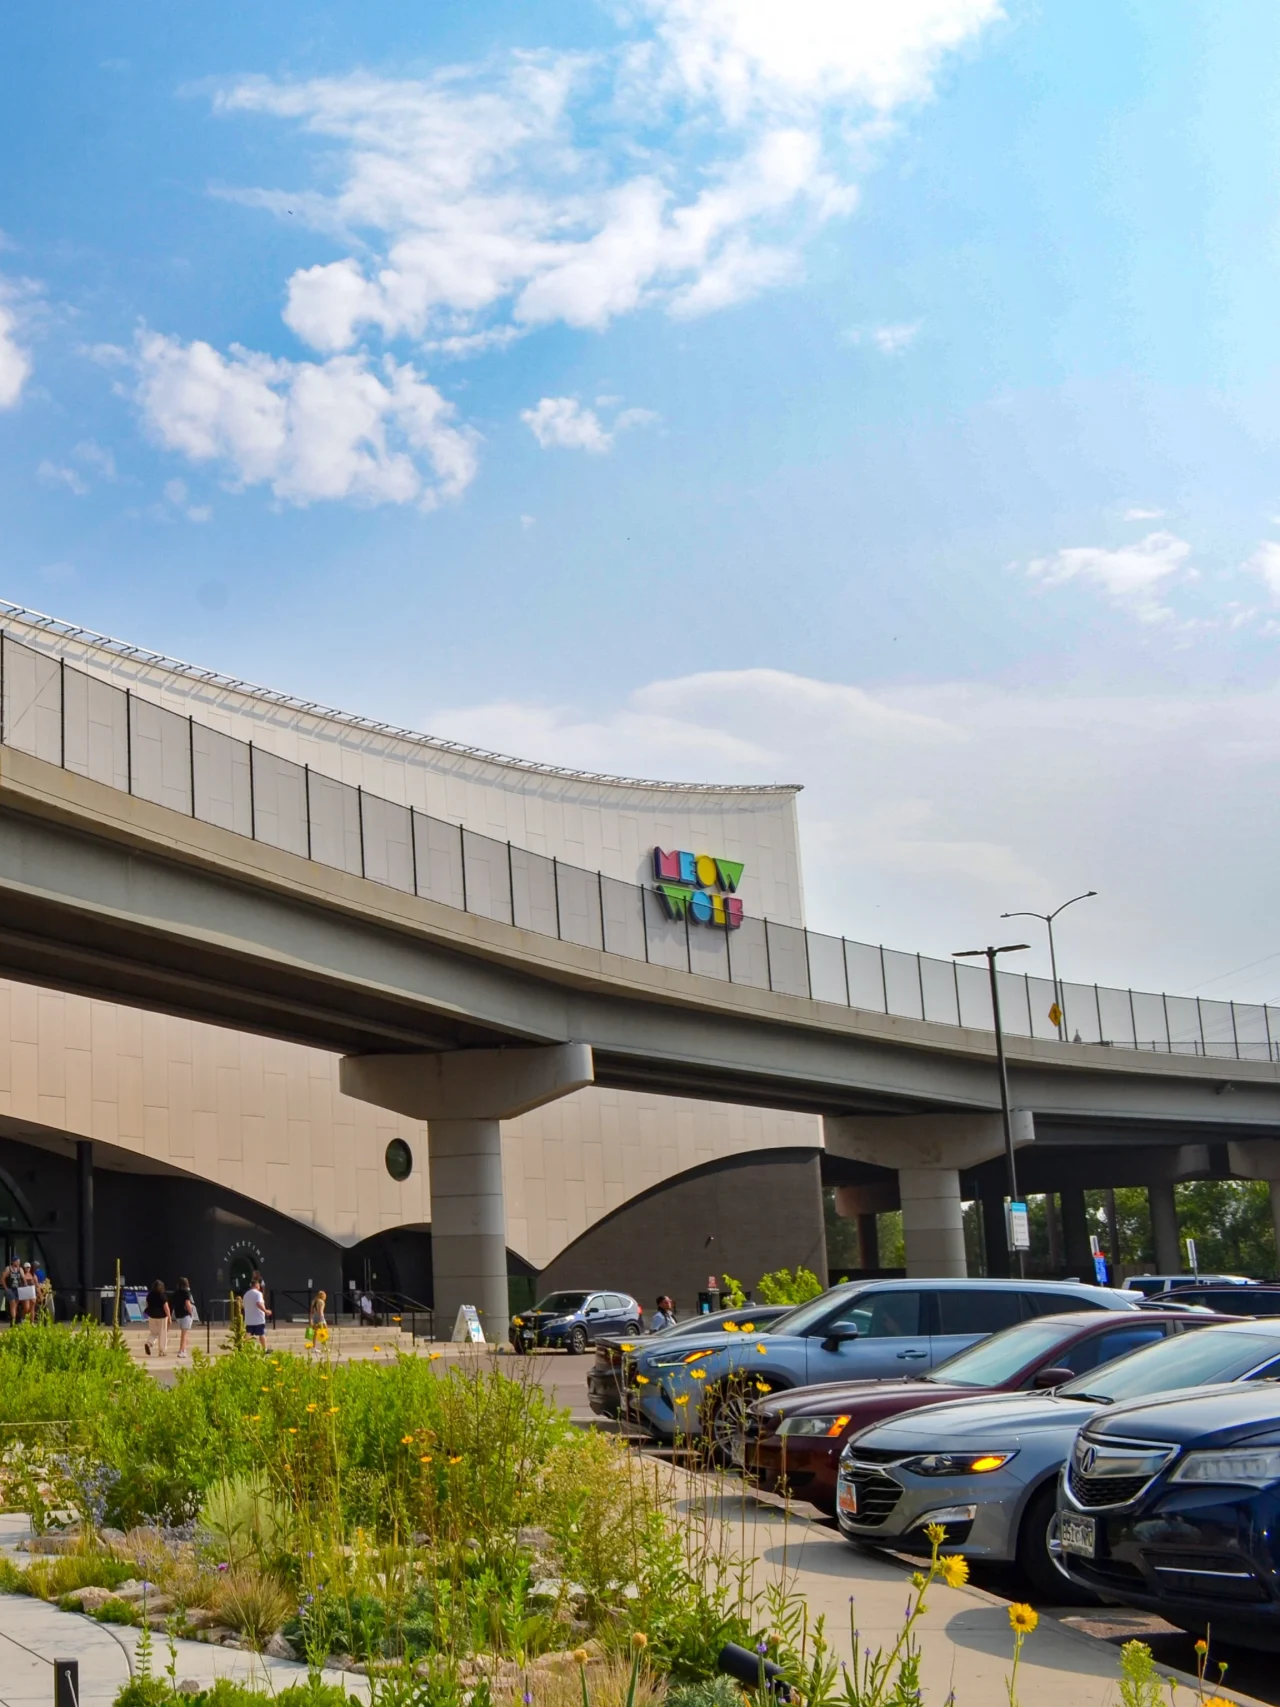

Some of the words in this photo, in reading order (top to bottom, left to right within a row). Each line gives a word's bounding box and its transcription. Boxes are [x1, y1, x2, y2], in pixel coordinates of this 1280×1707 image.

[653, 846, 745, 893] MEOW
[656, 884, 744, 929] WOLF
[223, 1240, 265, 1263] TICKETING
